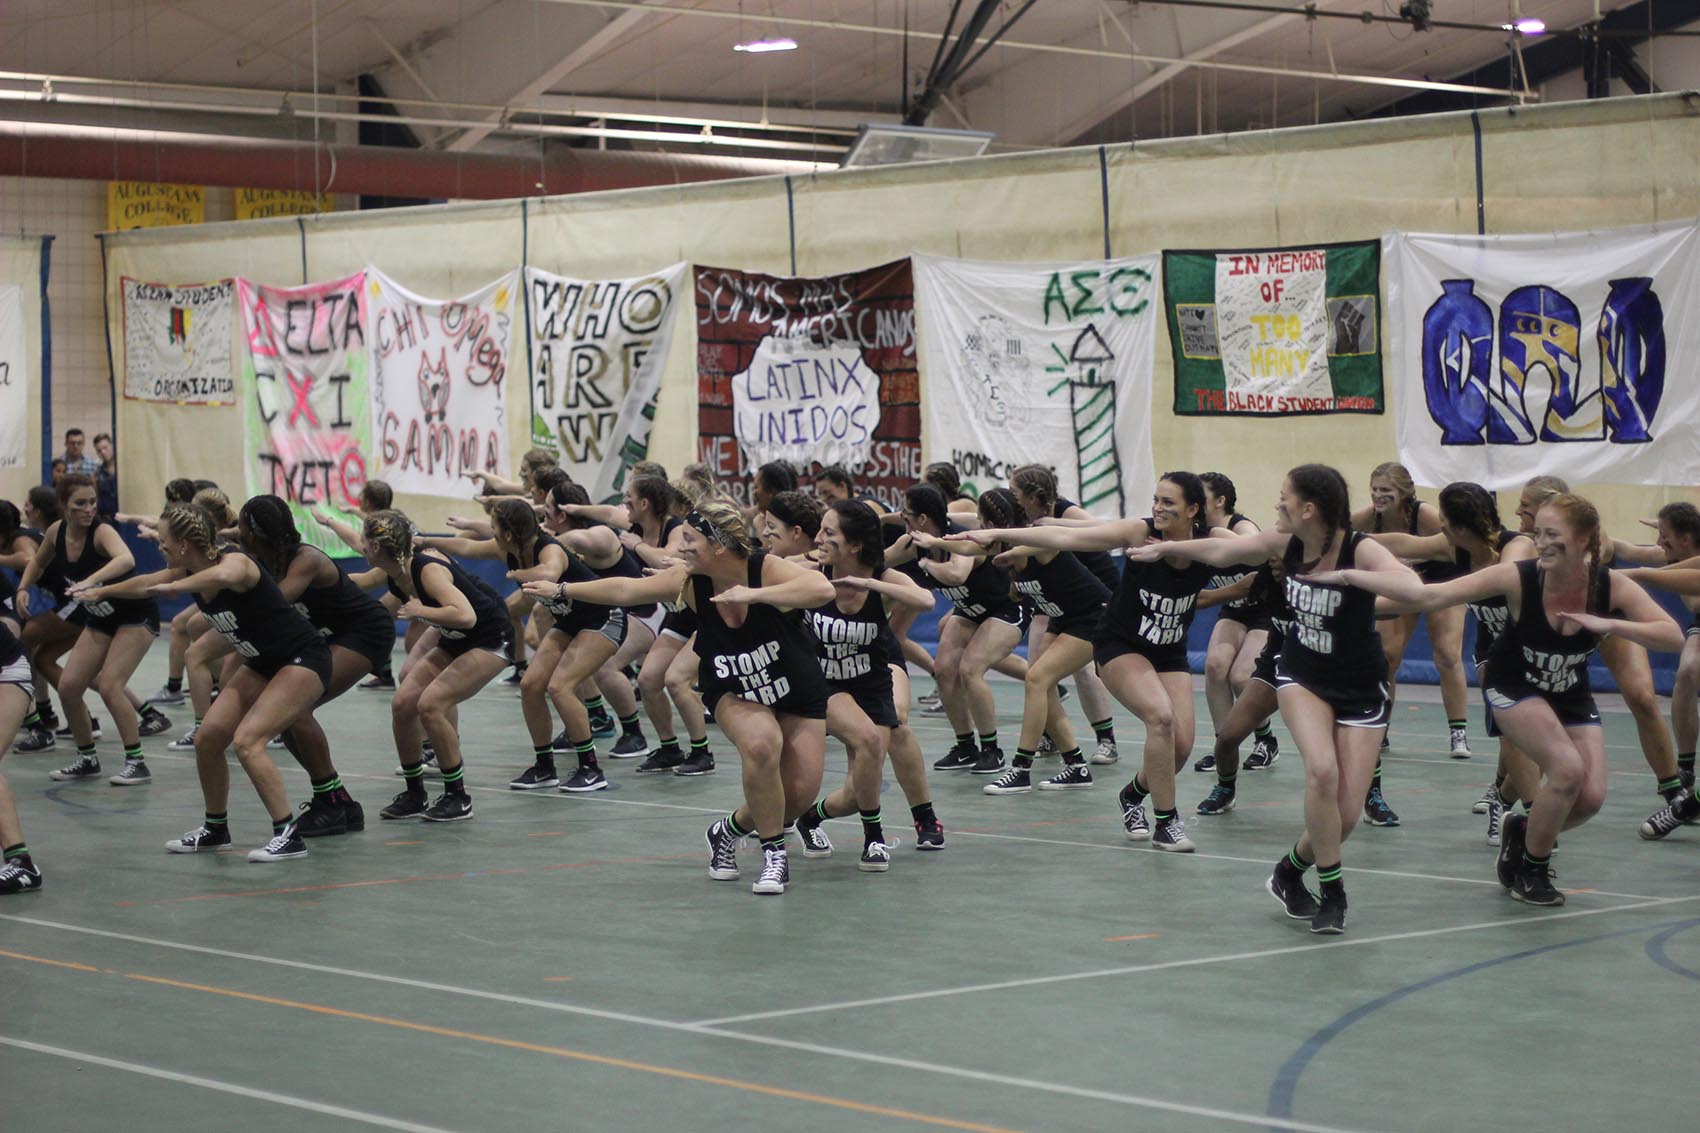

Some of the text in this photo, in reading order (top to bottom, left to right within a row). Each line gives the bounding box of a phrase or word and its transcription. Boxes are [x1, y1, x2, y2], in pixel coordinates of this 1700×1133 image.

[1229, 252, 1325, 275] IN MEMORY
[533, 277, 672, 340] WHO
[697, 270, 790, 325] SOMOS
[376, 304, 430, 358] CHI
[1249, 313, 1302, 342] TOO
[747, 356, 866, 401] LATINX
[1249, 346, 1312, 378] MANY
[1194, 388, 1225, 411] THE
[1228, 391, 1274, 412] BLACK
[1278, 396, 1333, 412] STUDENT
[738, 405, 868, 446] UNIDOS
[382, 412, 499, 477] GAMMA
[699, 436, 733, 476] WE
[890, 442, 922, 479] THE
[813, 611, 879, 646] STOMP
[1138, 615, 1184, 645] YARD
[1154, 612, 1180, 629] THE
[714, 640, 781, 679] STOMP
[824, 643, 859, 660] THE
[738, 668, 772, 691] THE
[1541, 663, 1569, 684] THE
